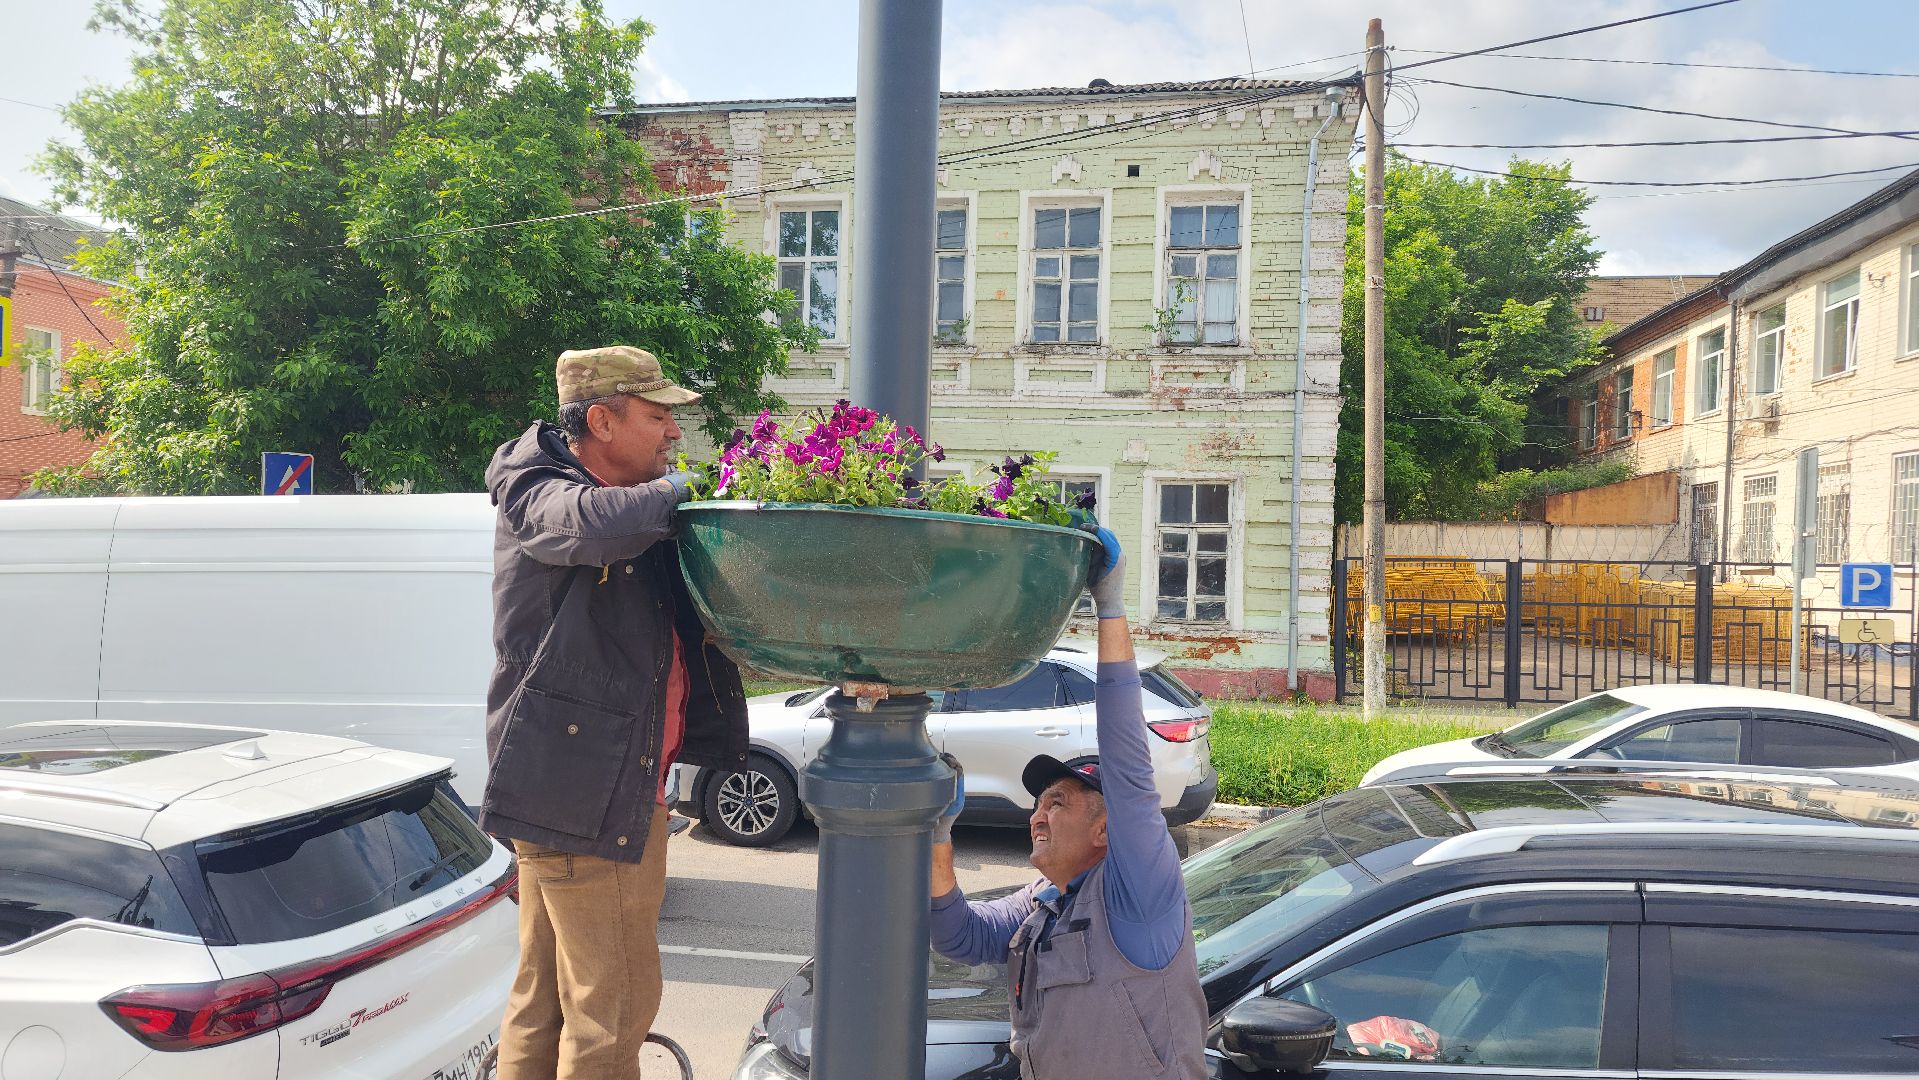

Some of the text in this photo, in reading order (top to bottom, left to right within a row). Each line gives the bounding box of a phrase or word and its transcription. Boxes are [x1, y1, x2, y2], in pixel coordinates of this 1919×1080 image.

[1852, 567, 1882, 603] P
[374, 875, 484, 934] CHERY
[300, 1018, 352, 1046] TIGGO
